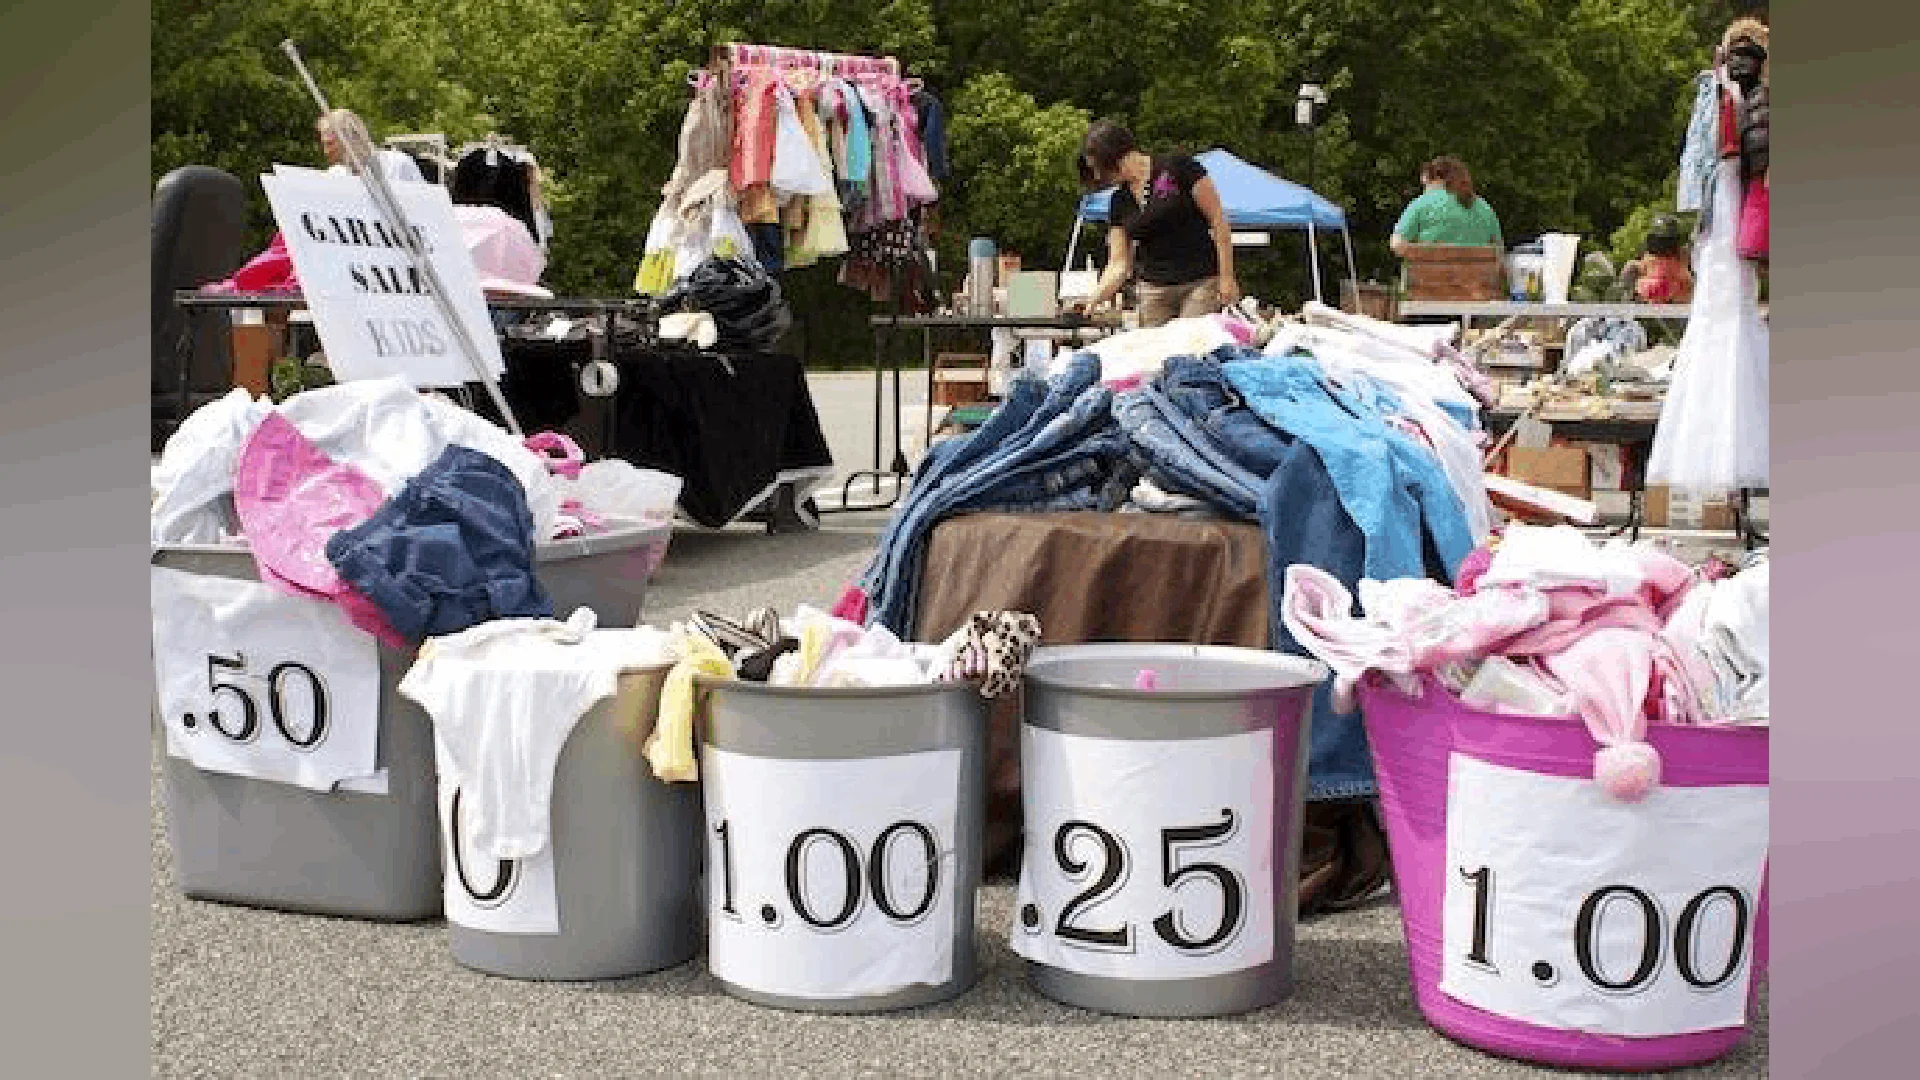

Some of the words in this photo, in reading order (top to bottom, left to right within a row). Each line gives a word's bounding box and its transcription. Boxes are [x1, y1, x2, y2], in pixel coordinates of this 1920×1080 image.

[366, 319, 447, 357] KIDS
[183, 650, 332, 753] .50
[714, 819, 943, 934] 1.00
[1021, 808, 1248, 957] .25
[1459, 865, 1752, 997] 1.00
